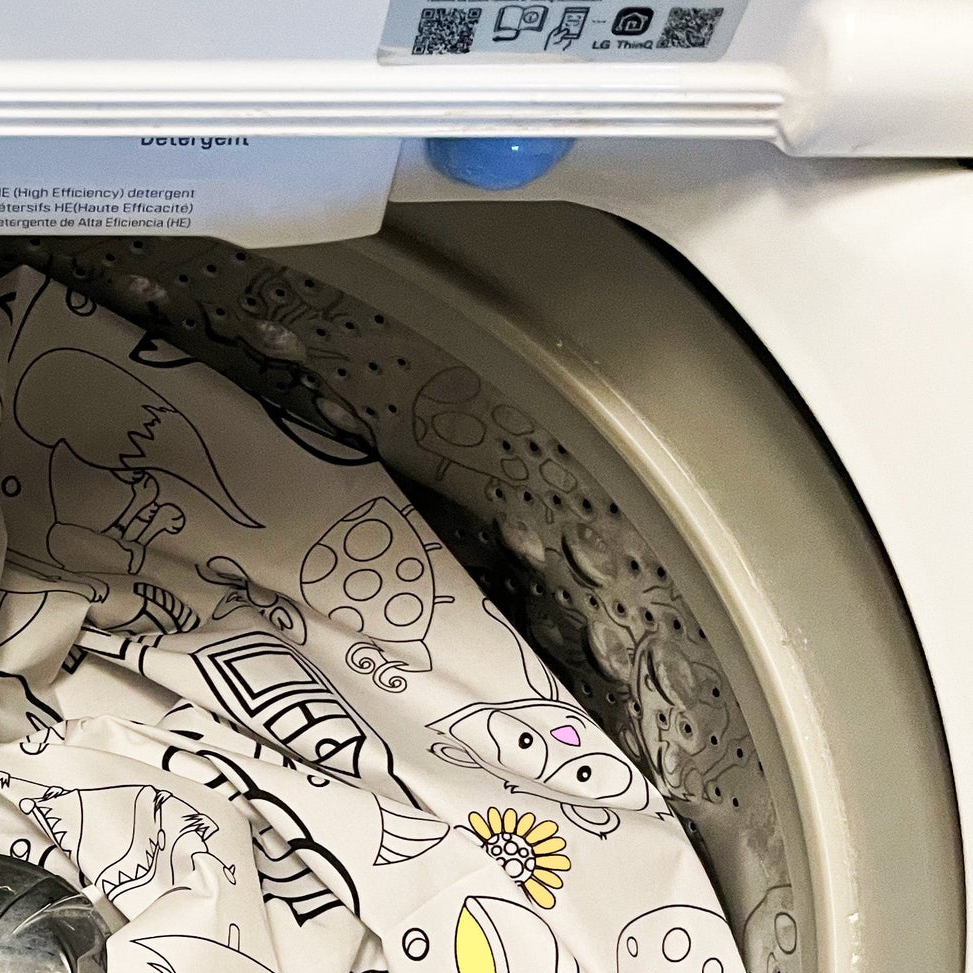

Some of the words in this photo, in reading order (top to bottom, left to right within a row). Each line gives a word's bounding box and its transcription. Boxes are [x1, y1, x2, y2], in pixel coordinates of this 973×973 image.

[592, 40, 611, 50] LG
[617, 40, 654, 50] ThinQ
[13, 187, 49, 199] (High
[51, 187, 125, 199] Efficiency)
[127, 187, 195, 199] detergent
[54, 202, 119, 214] HE(Haute
[122, 202, 194, 214] Efficacité)
[59, 217, 75, 228] de
[78, 217, 103, 228] Alta
[105, 217, 164, 228] Eficiencia
[166, 217, 191, 228] (HE)
